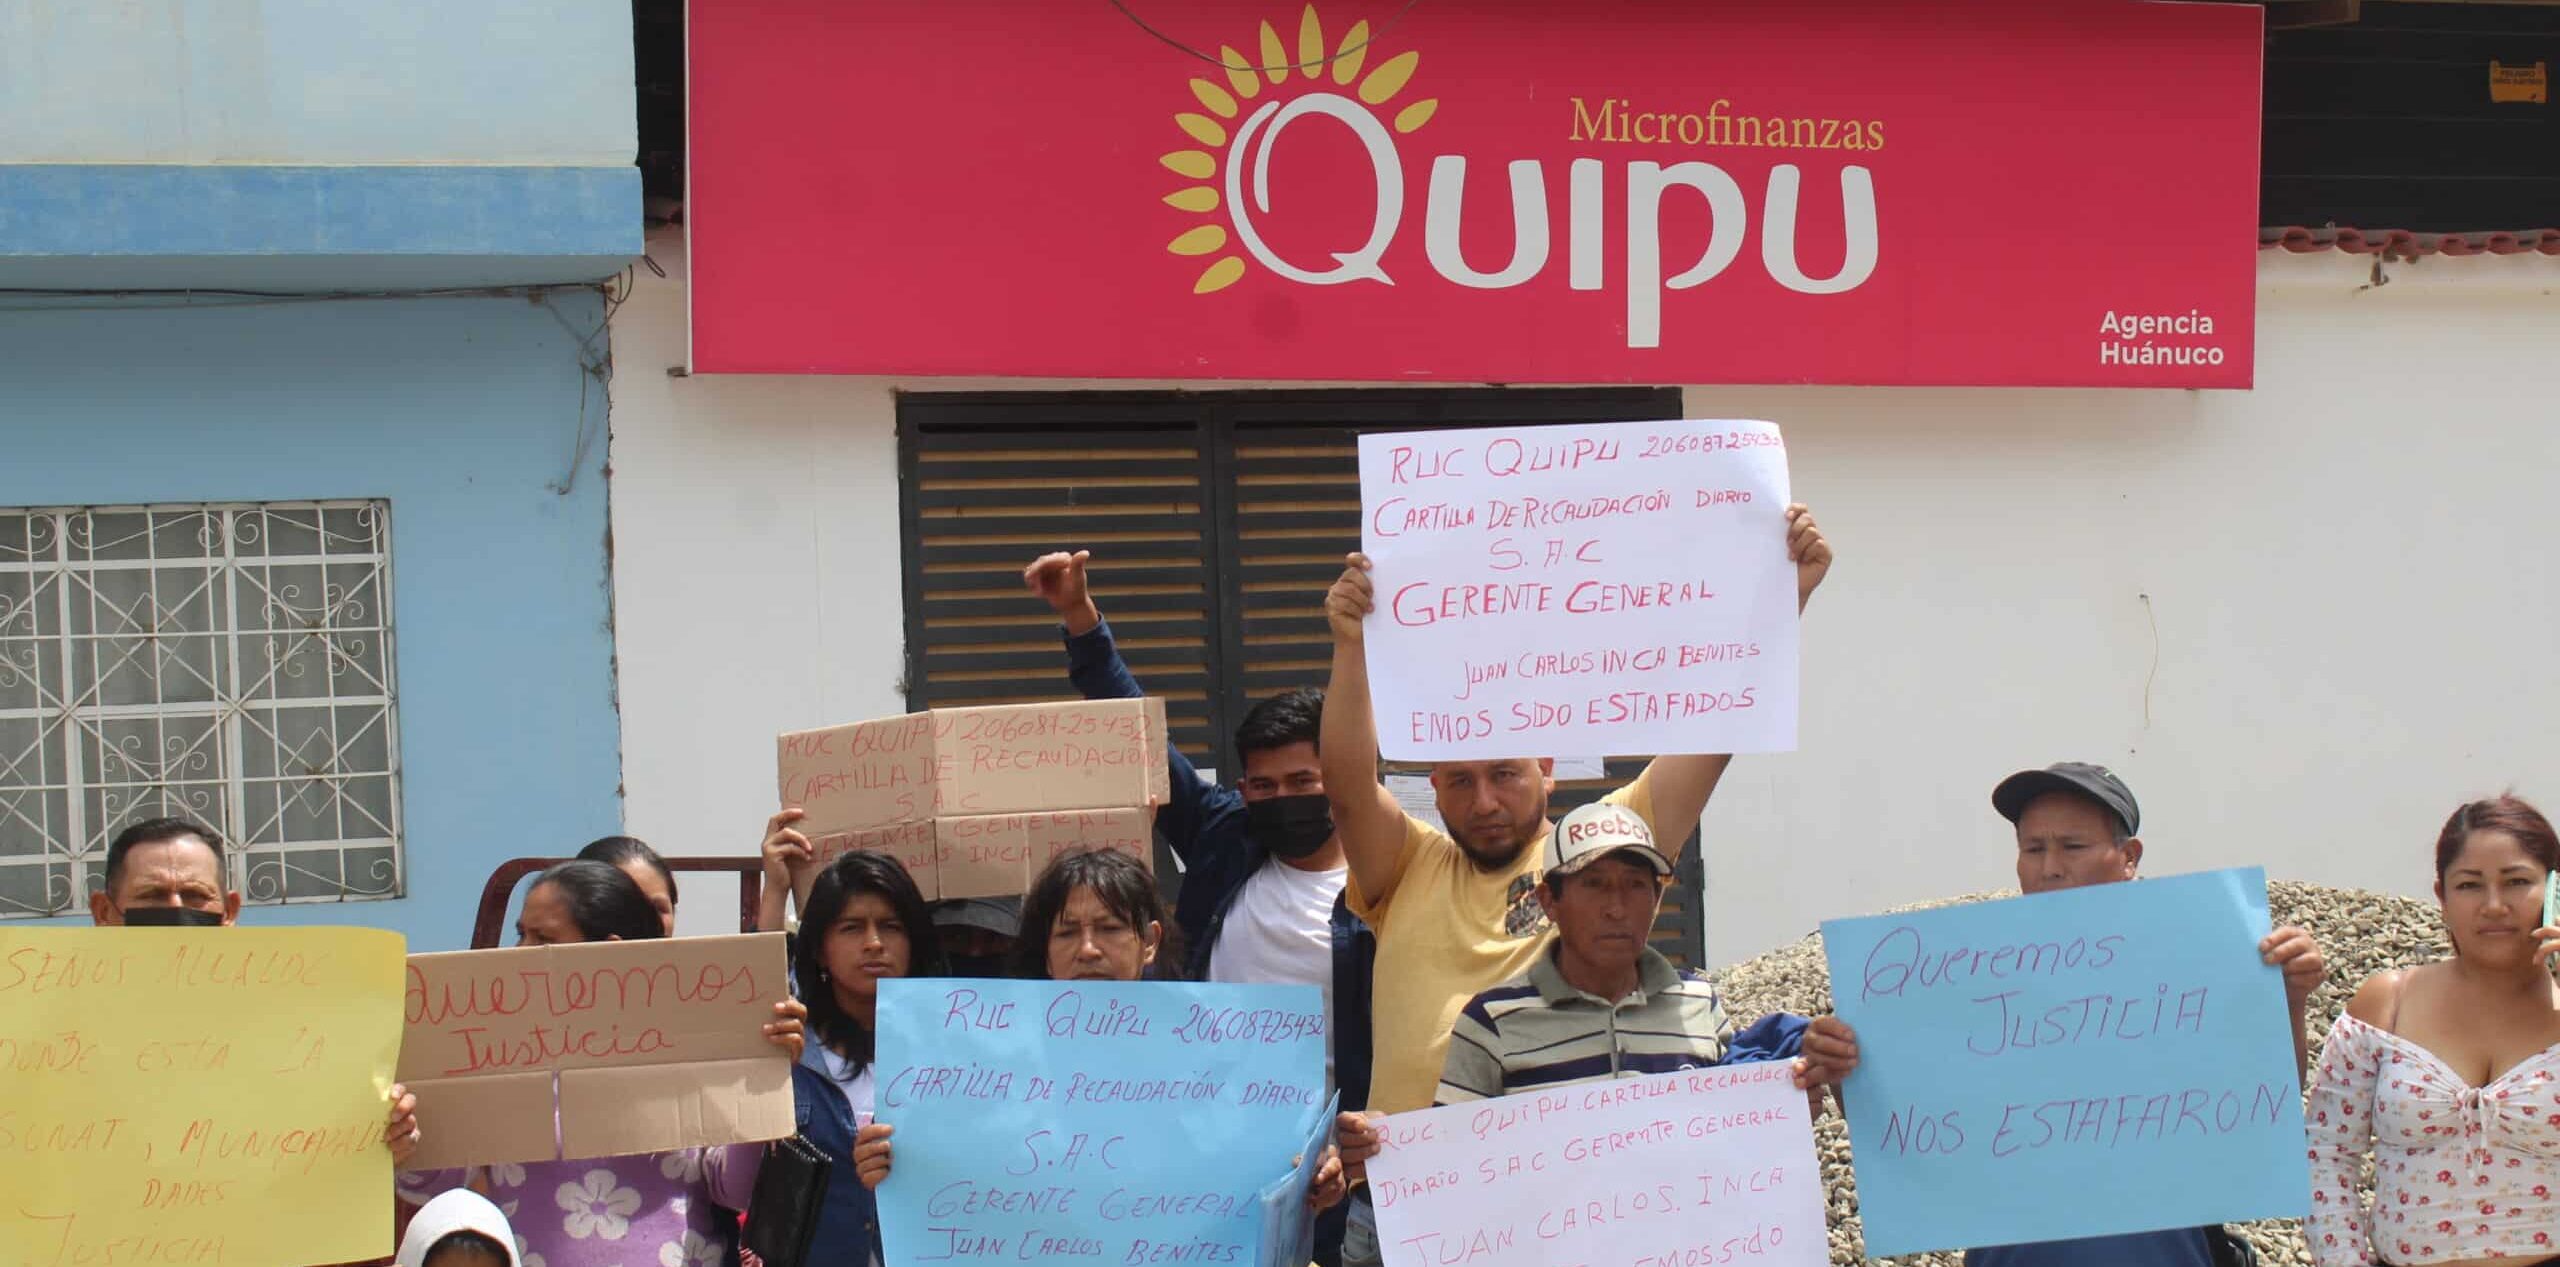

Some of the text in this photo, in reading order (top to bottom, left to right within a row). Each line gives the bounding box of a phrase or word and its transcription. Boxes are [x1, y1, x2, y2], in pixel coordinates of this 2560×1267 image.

[1569, 97, 1886, 152] Microfinanzas
[2100, 309, 2213, 338] Agencia
[2100, 339, 2223, 366] Huánuco
[1390, 446, 1465, 484] RUC
[1374, 498, 1475, 537] CARTILLA
[1393, 580, 1714, 626] GERENTE GENERAL
[1454, 660, 1508, 700] JUAN
[1518, 651, 1595, 679] CARLOS
[1678, 643, 1761, 668] BENITES
[852, 717, 954, 757] QUIPU
[1411, 687, 1755, 744] EMOS SIDO ESTAFADOS
[785, 763, 909, 804] CARTILLA
[918, 755, 953, 785] DE
[817, 824, 927, 861] ERENTE
[968, 844, 1032, 863] INCA
[1862, 926, 2125, 1001] Queremos
[1172, 1004, 1325, 1044] 20608725432
[444, 1024, 673, 1076] Justicia
[885, 1061, 1013, 1108] CARTILLA
[1026, 1076, 1055, 1101] DE
[1880, 1083, 2288, 1157] NOS ESTAFARON
[928, 1181, 1257, 1220] GERENTE GENERAL
[1400, 1226, 1514, 1267] JUAN
[1698, 1166, 1784, 1206] INCA
[916, 1227, 1007, 1260] JUAN
[1019, 1230, 1103, 1260] CARLOS
